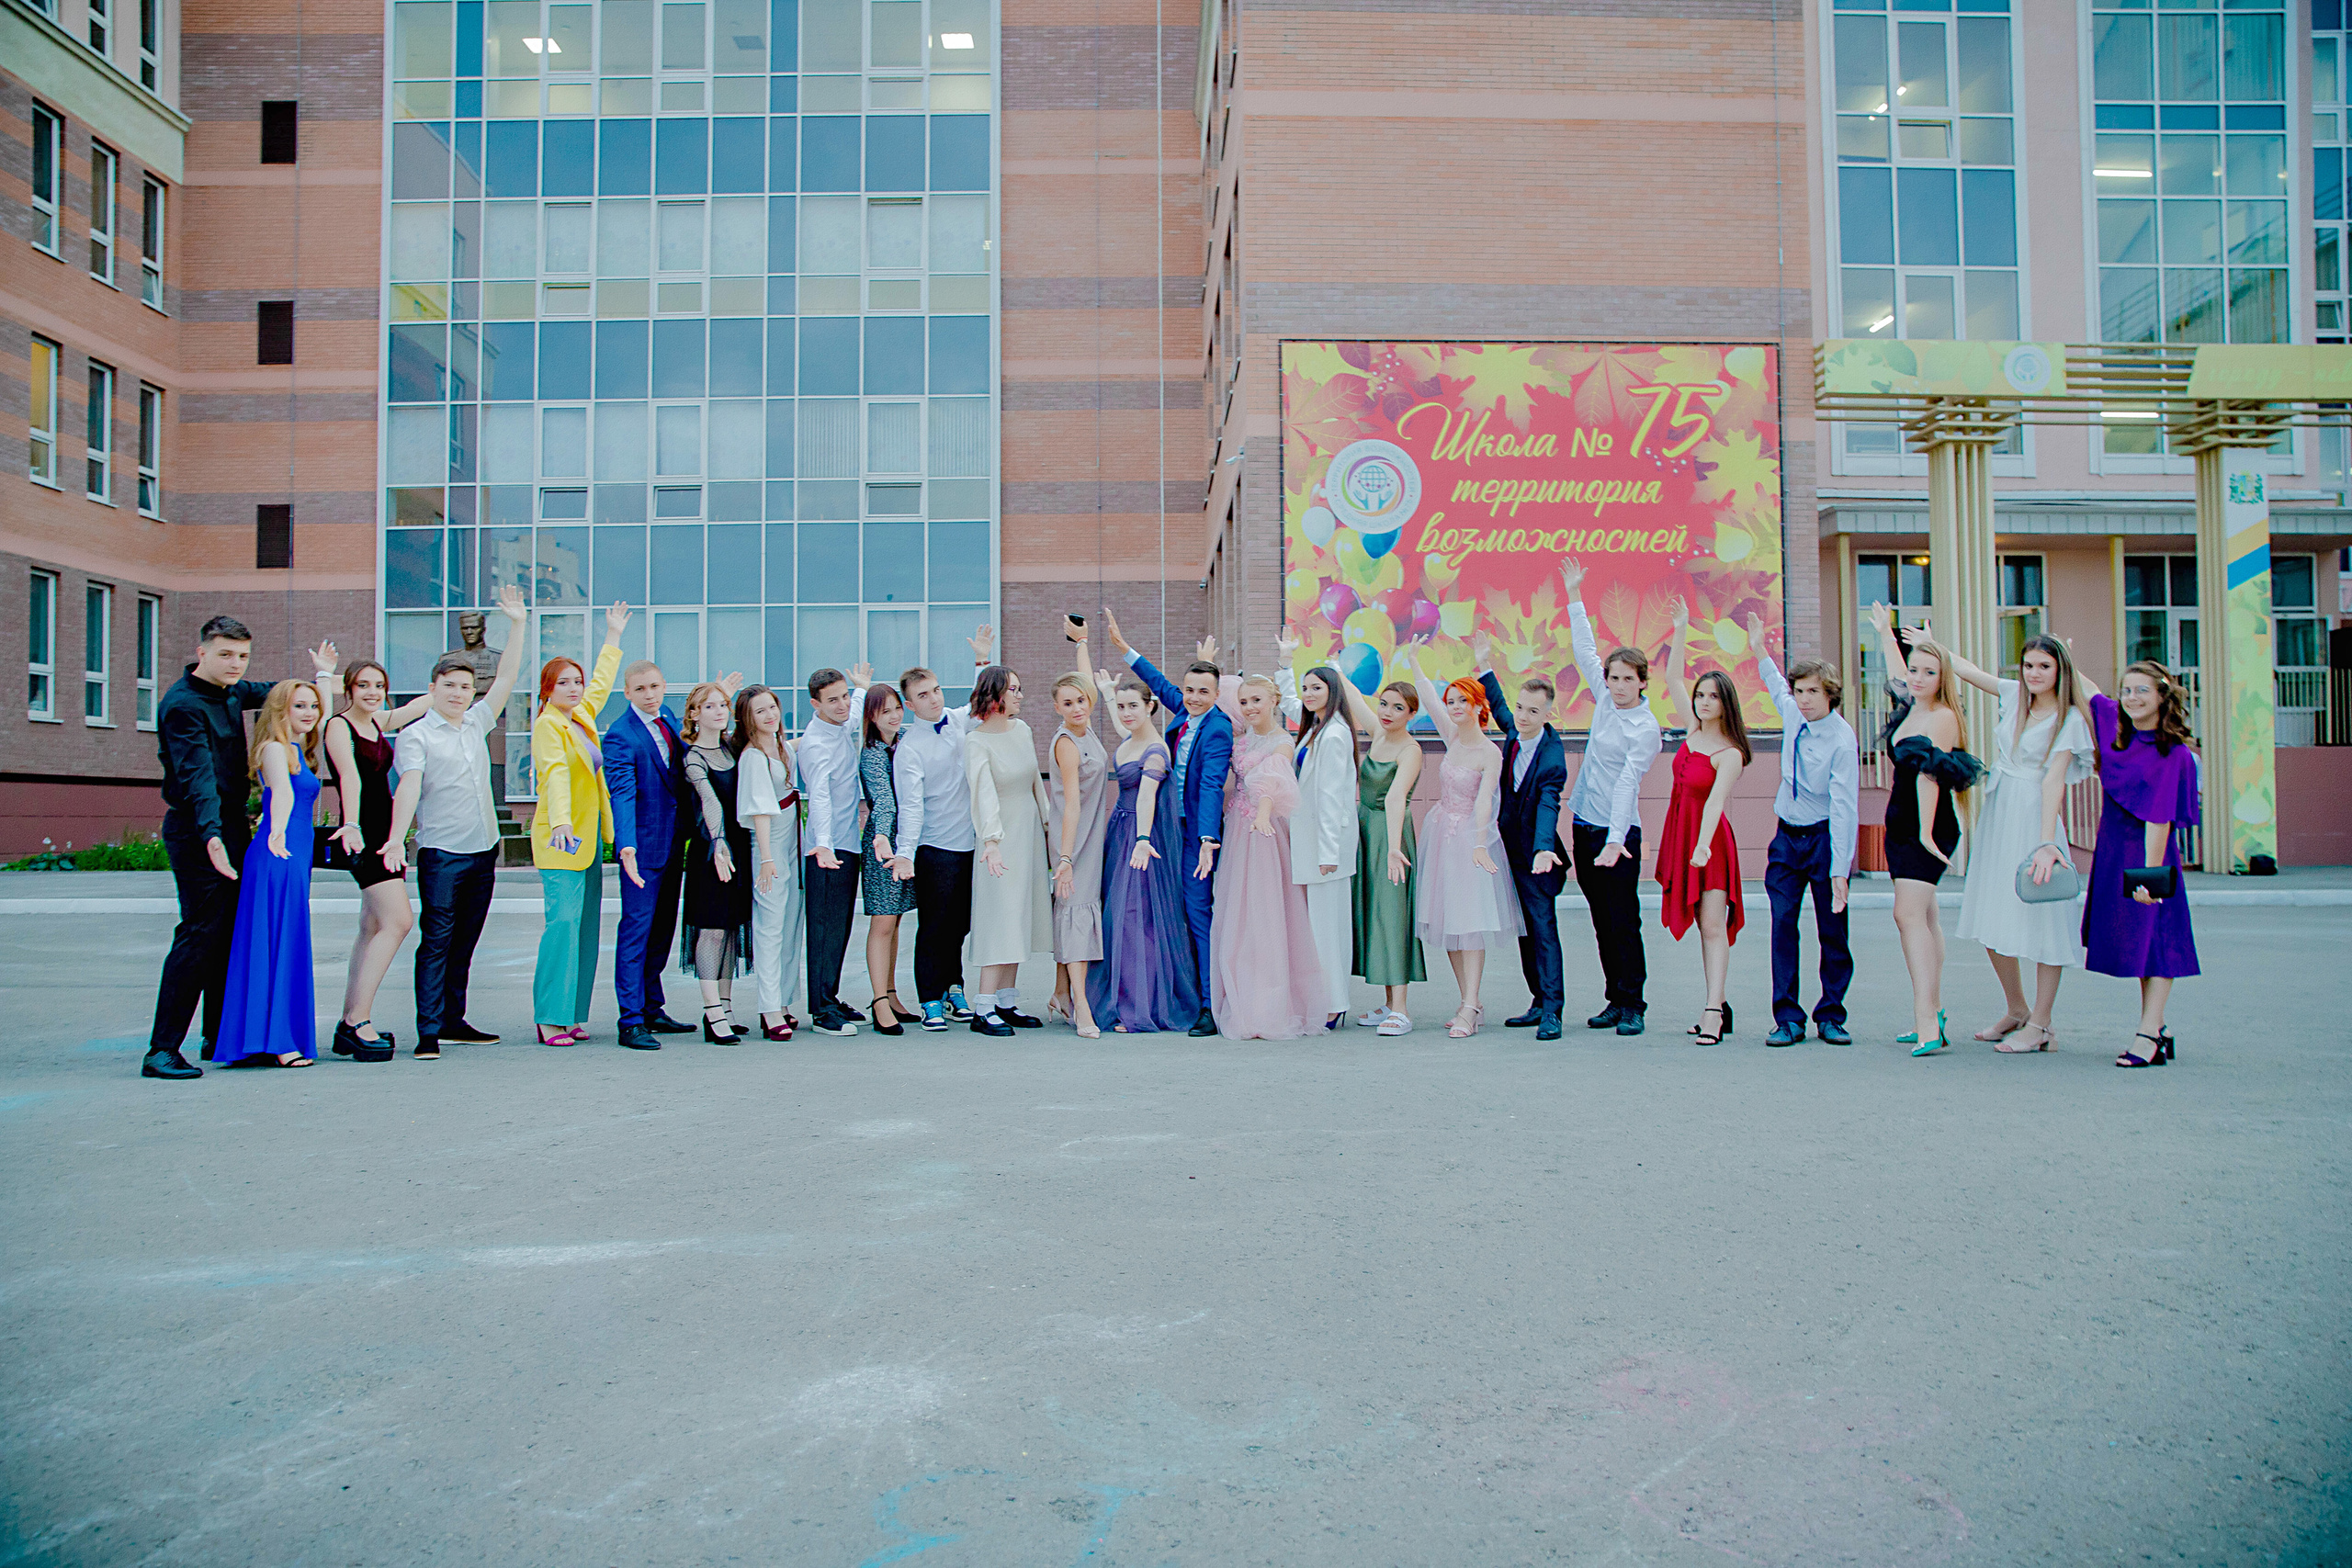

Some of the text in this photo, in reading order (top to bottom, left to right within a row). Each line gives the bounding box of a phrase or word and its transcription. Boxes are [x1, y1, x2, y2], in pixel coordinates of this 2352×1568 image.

[1396, 386, 1722, 467] Школа № 75
[1450, 479, 1664, 517] территория
[1415, 512, 1690, 568] возможностей
